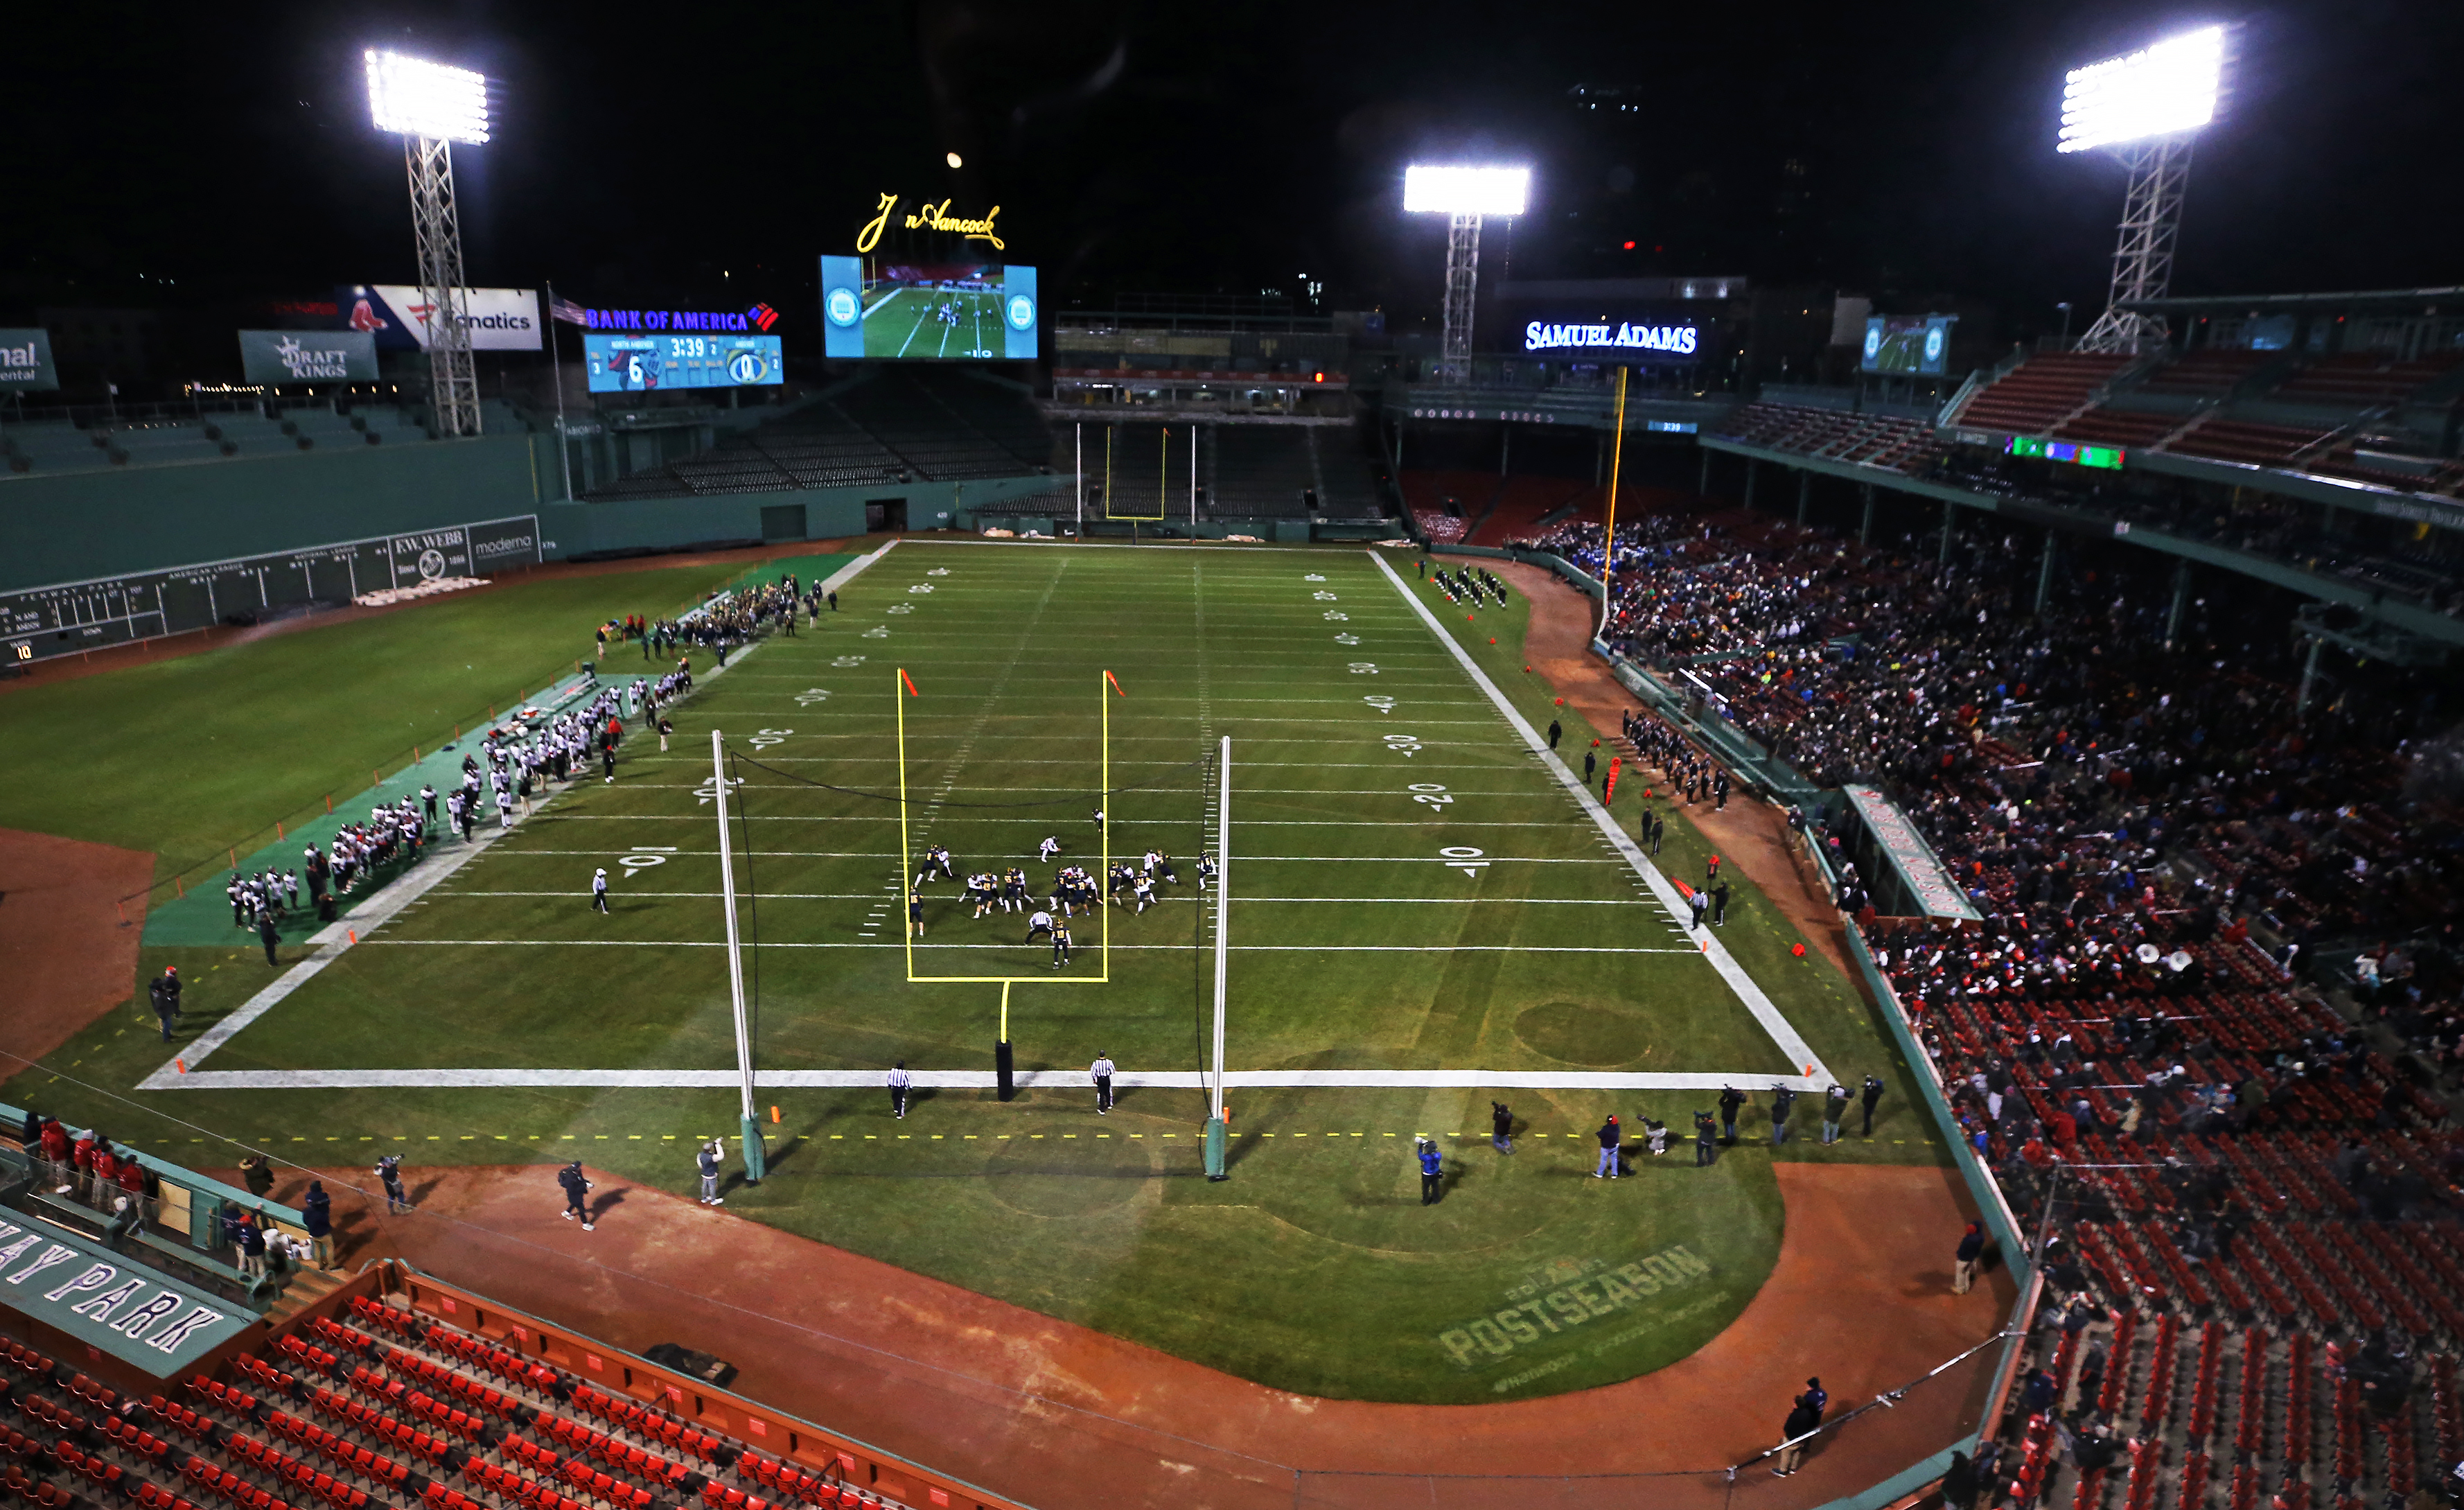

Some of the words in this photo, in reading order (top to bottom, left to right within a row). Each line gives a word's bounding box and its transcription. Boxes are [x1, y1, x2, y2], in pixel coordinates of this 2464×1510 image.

[917, 198, 1005, 250] Hancock
[586, 309, 642, 330] BANK
[644, 310, 669, 330] OF
[672, 311, 749, 331] AMERICA
[671, 337, 705, 358] 3:39
[1525, 321, 1614, 350] SAMUEL
[1613, 322, 1697, 354] ADAMS
[283, 350, 347, 367] DRAFT
[711, 344, 718, 356] 2
[292, 364, 347, 379] KINGS
[593, 362, 601, 376] 3
[628, 355, 643, 383] 6
[741, 353, 753, 380] 0
[1664, 422, 1681, 432] 3:39
[422, 530, 464, 548] WEBB
[475, 535, 532, 555] moderna
[168, 567, 211, 580] AMERICAN
[19, 587, 77, 603] FENWAY
[88, 580, 123, 592] PARK
[17, 644, 33, 660] 10
[748, 728, 794, 746] 30
[1383, 735, 1423, 750] 30
[1407, 783, 1454, 804] 20
[618, 847, 678, 866] 10
[1439, 846, 1491, 868] 10
[43, 1263, 225, 1354] PARK
[1439, 1245, 1711, 1367] POSTSEASON
